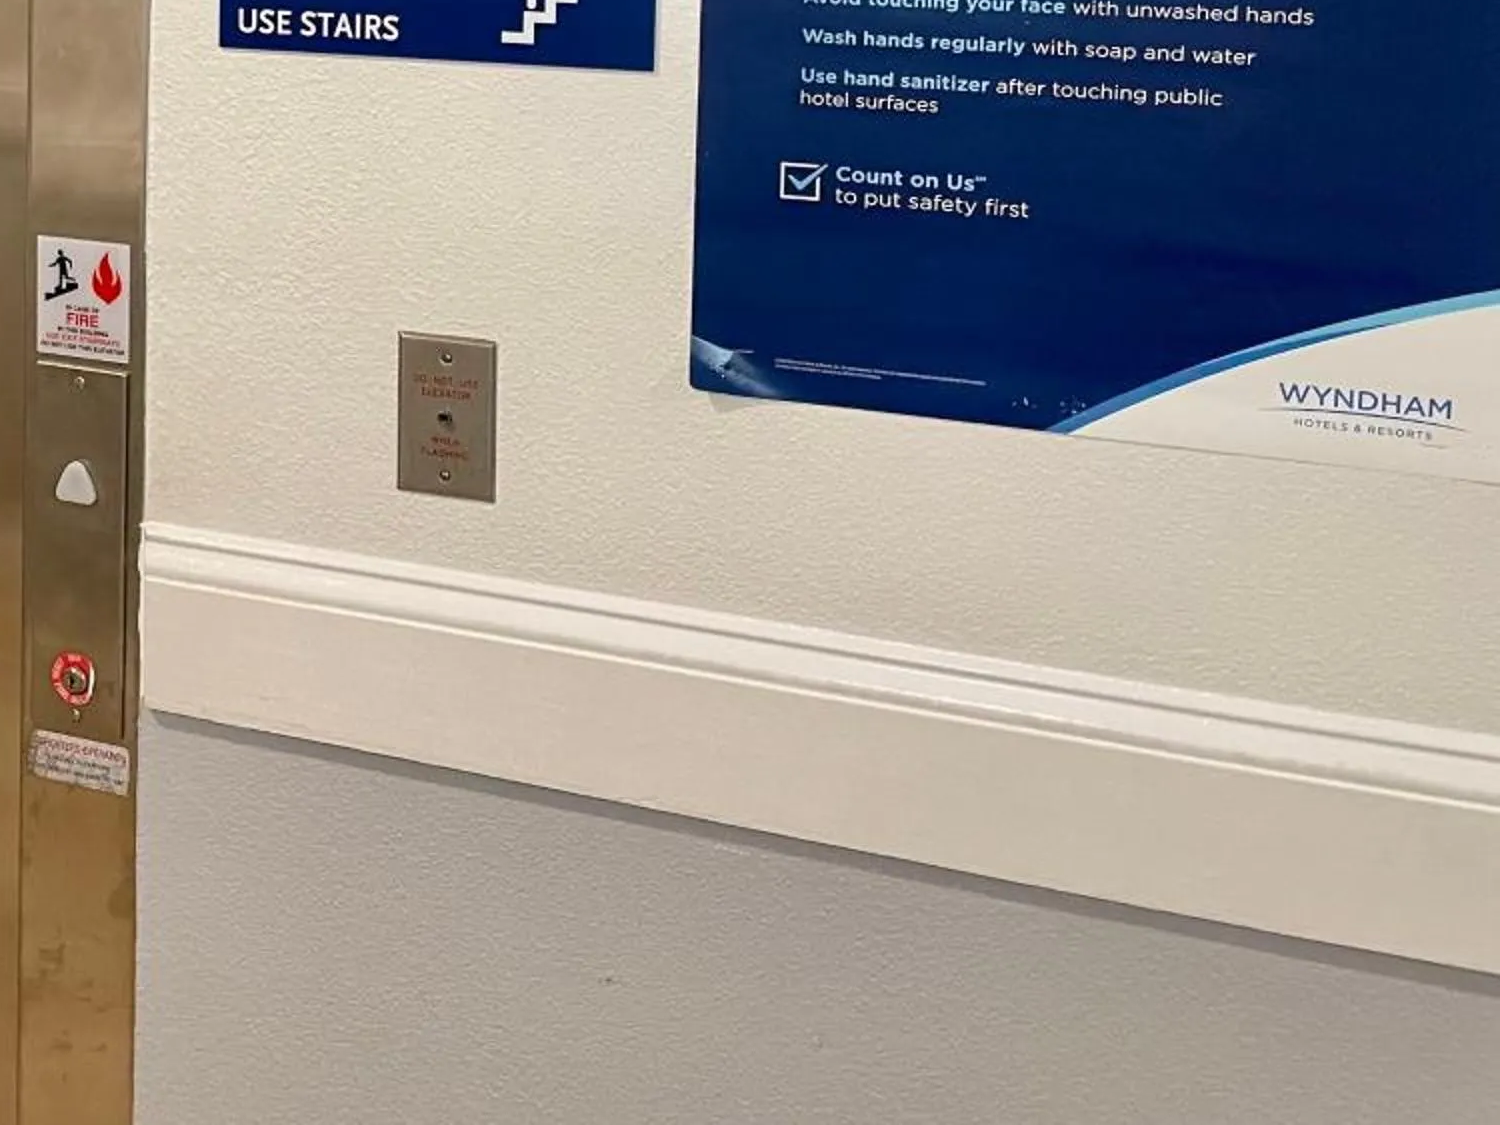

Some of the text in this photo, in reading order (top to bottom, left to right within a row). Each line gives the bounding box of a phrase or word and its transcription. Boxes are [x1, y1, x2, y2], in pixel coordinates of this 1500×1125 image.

[237, 7, 399, 41] USE STAIRS
[1073, 0, 1119, 17] with
[1127, 3, 1238, 22] unwashed
[1246, 6, 1315, 26] hands
[802, 28, 1257, 66] Wash hands regularly with soap and water
[800, 67, 1224, 107] Use hand sanitizer after touching public
[799, 89, 939, 114] hotel surfaces
[835, 166, 903, 186] Count
[910, 173, 938, 189] on
[835, 188, 1030, 218] to put safety first
[67, 312, 99, 328] FIRE
[1279, 382, 1453, 420] WYNDHAM
[1293, 418, 1348, 433] HOTELS
[1367, 426, 1433, 441] RESORTS
